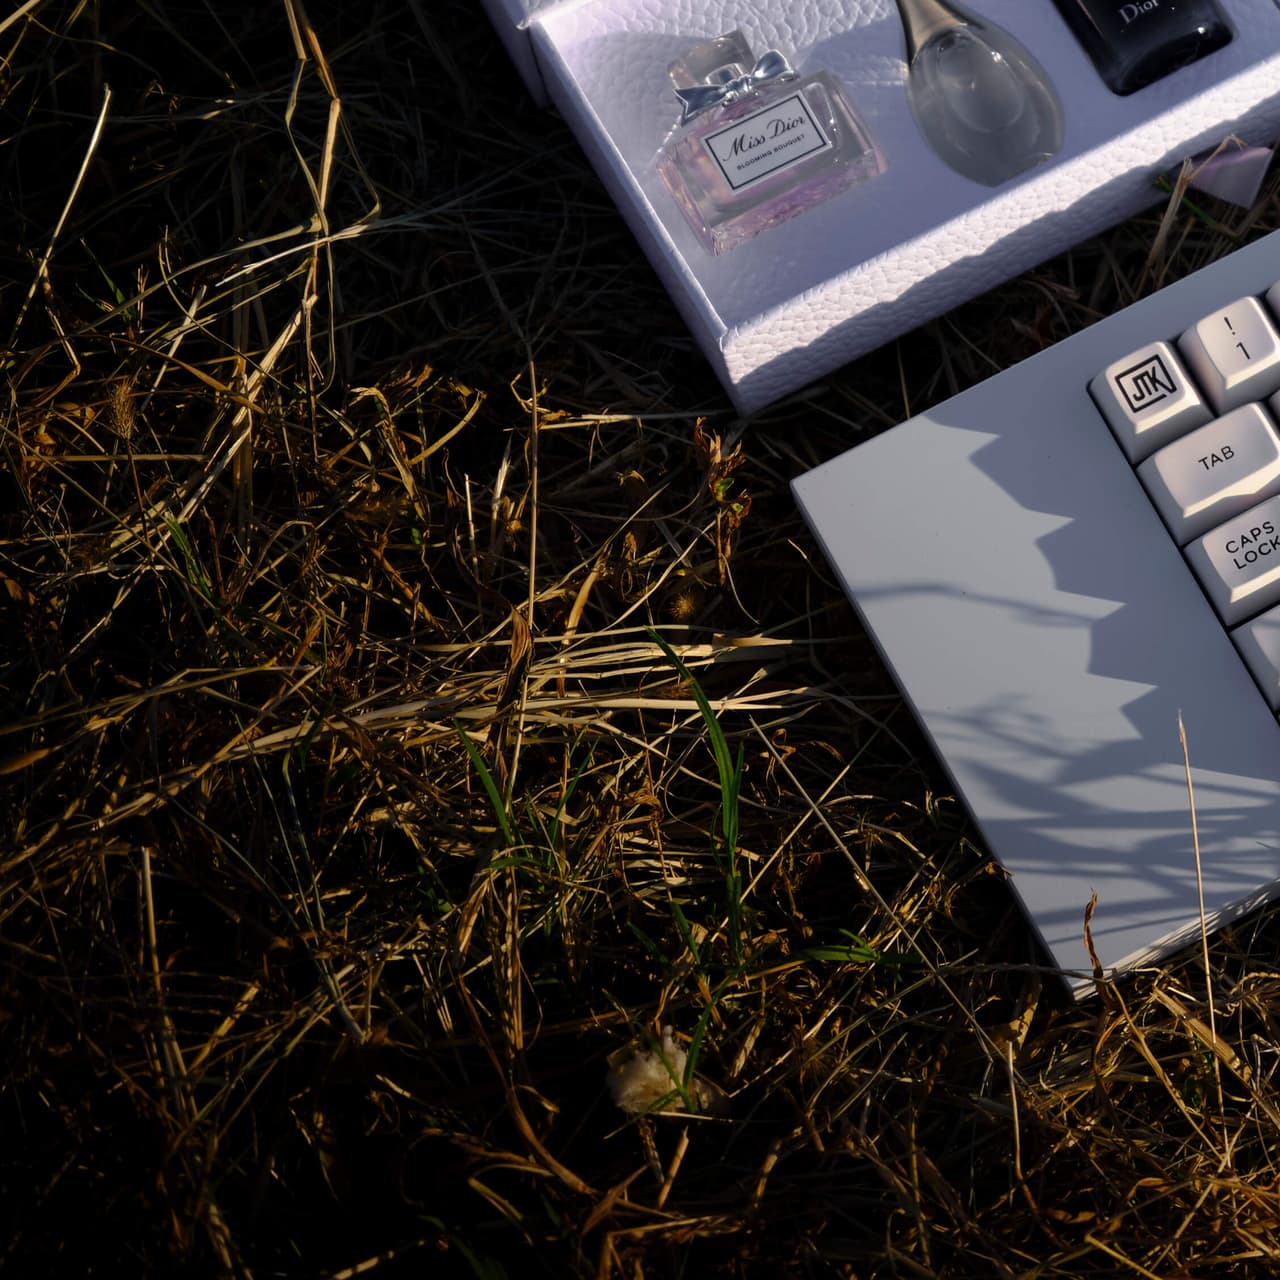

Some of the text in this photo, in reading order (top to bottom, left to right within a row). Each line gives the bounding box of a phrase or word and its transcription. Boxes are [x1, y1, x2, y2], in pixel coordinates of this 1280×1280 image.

[723, 117, 805, 161] Miss Dior
[1224, 317, 1235, 335] !
[1236, 342, 1250, 359] 1
[1198, 446, 1234, 470] TAB
[1225, 521, 1275, 553] CAPS
